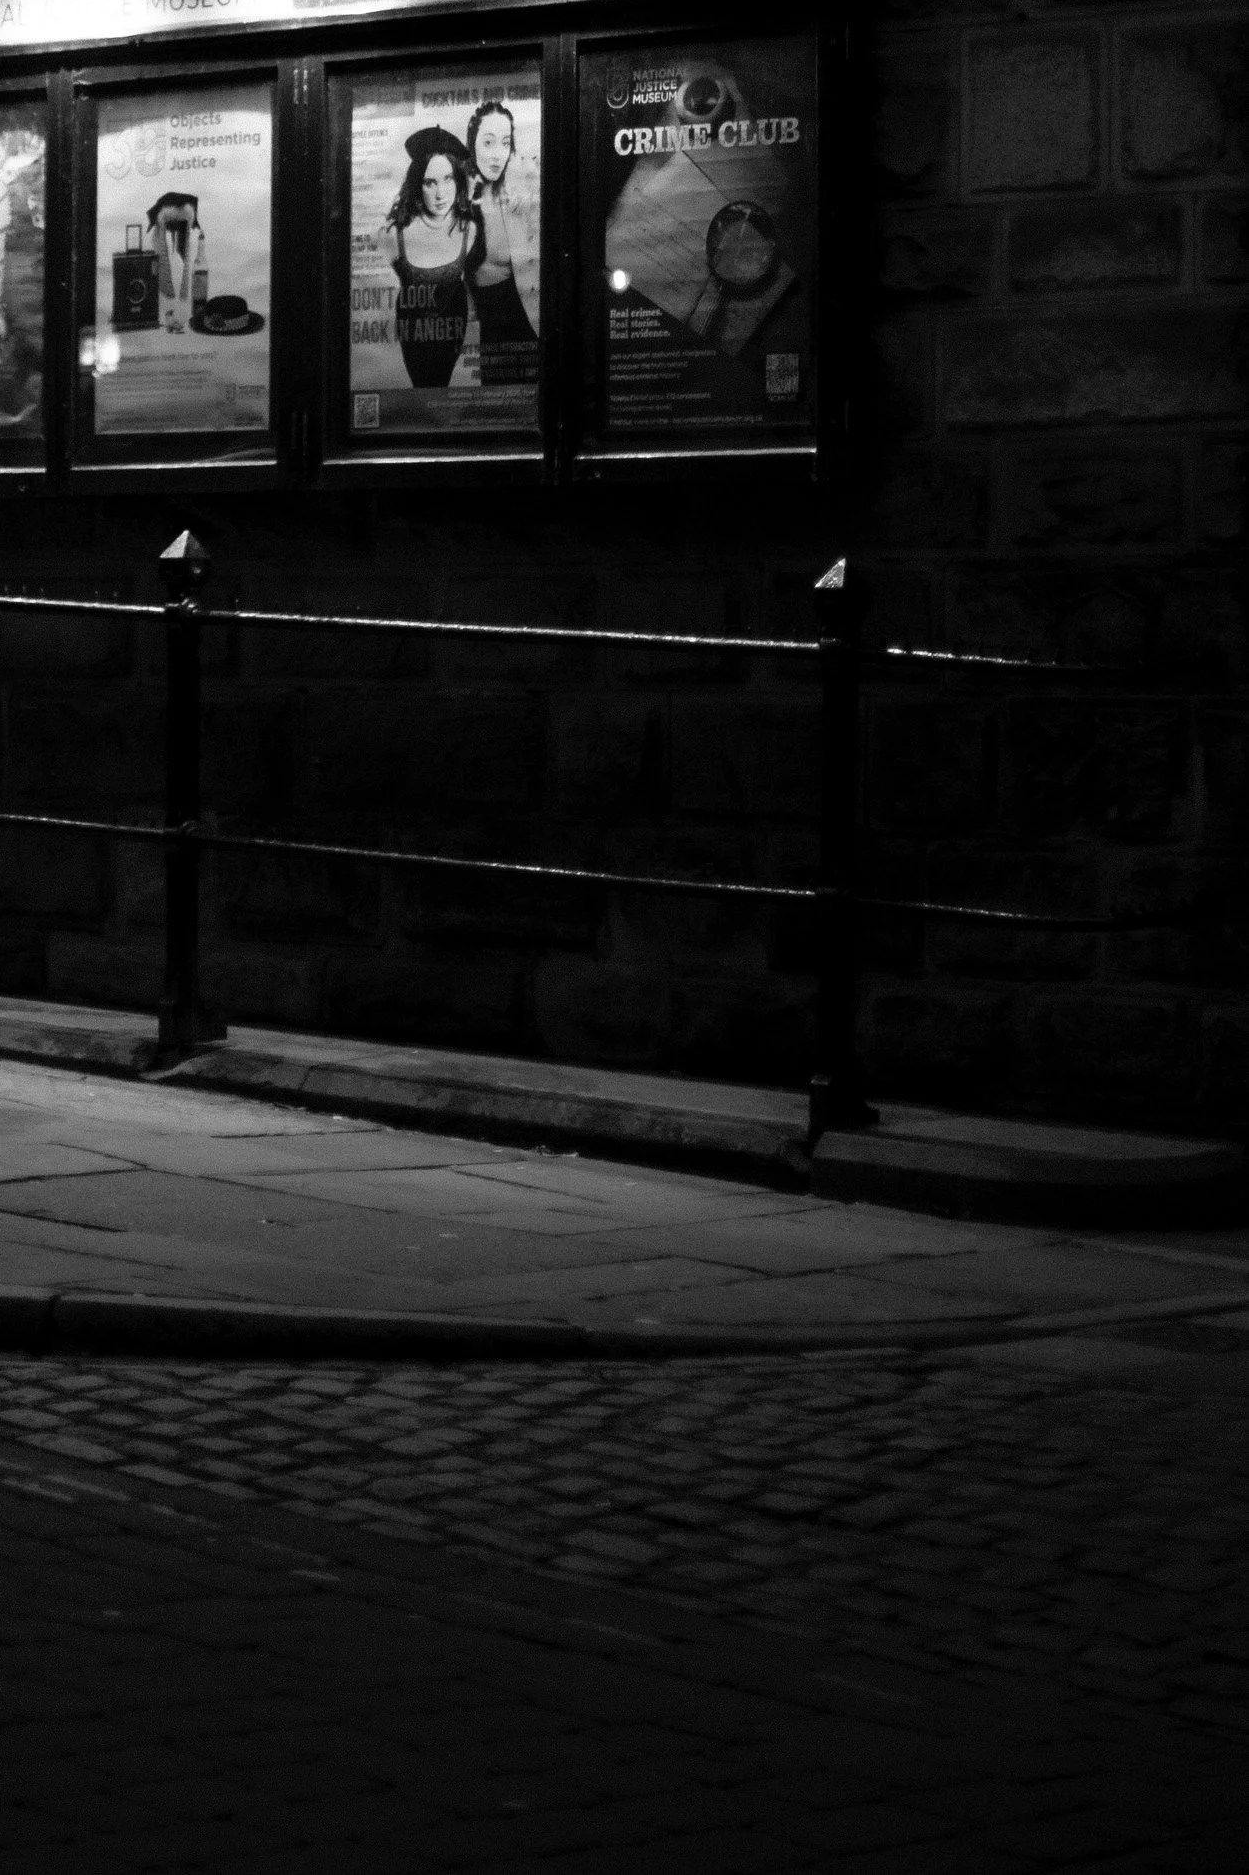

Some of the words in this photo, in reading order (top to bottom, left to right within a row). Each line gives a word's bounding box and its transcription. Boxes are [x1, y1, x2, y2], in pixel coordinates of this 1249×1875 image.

[632, 67, 686, 81] NATIONA
[632, 79, 677, 93] JUSTICE
[632, 90, 678, 105] MUSEUM
[170, 112, 222, 130] Objects
[170, 130, 261, 151] Representing
[614, 122, 712, 156] CRIME
[718, 117, 800, 148] CLUB
[170, 155, 217, 172] Justice
[352, 286, 396, 311] DON'T
[398, 284, 439, 309] LOOK
[609, 307, 629, 319] Real
[352, 319, 390, 344] BACK
[392, 319, 411, 343] IN
[609, 318, 629, 329] Real
[609, 329, 629, 340] Real
